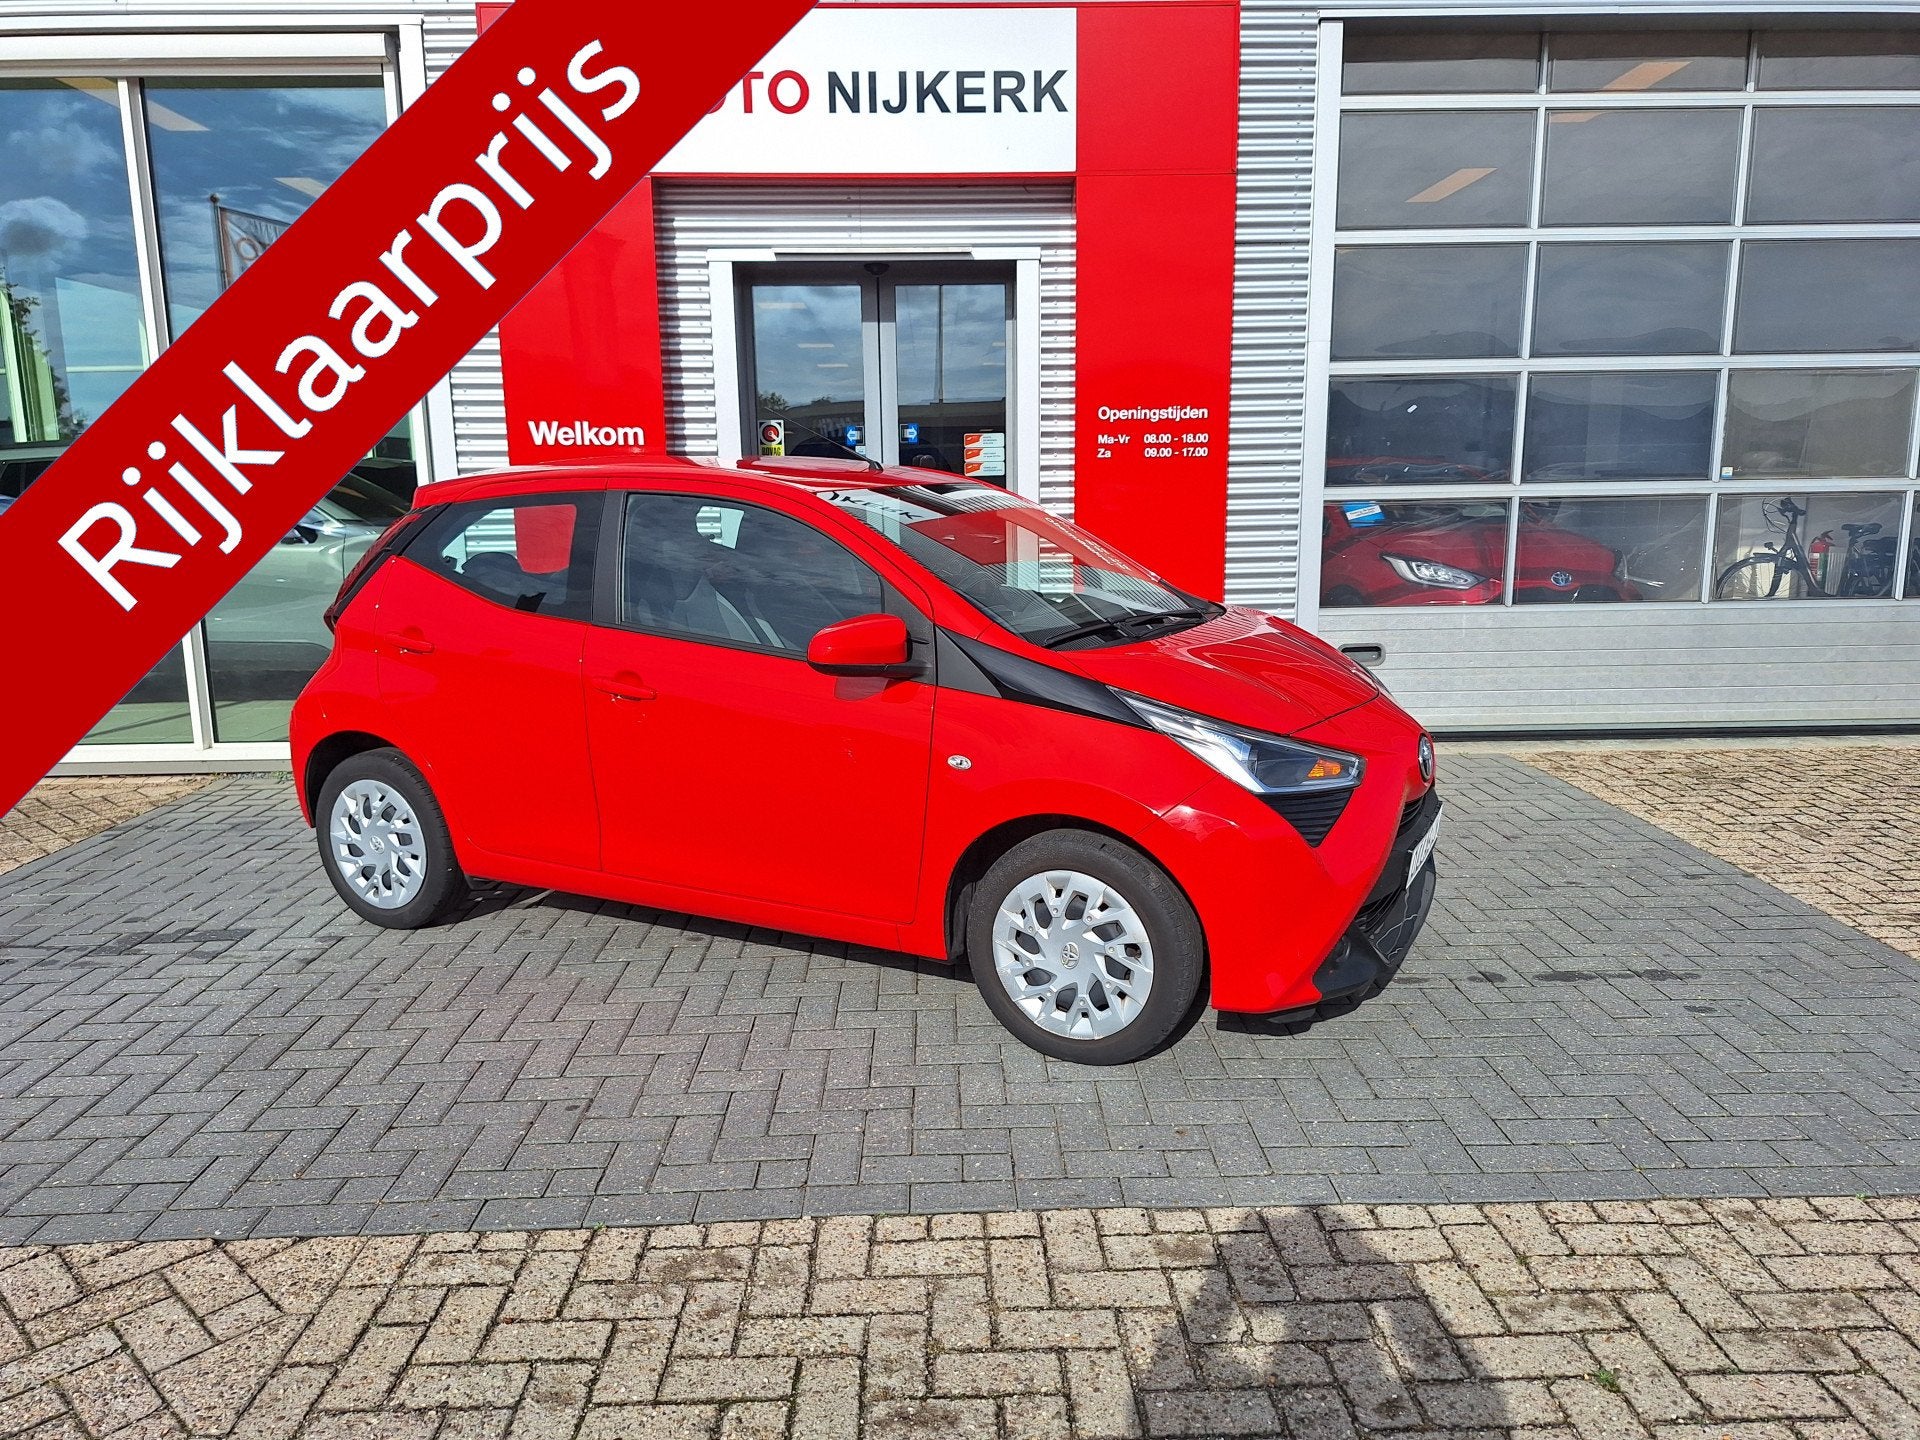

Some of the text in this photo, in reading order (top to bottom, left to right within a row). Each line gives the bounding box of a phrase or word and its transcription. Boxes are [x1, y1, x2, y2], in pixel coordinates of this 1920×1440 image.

[705, 70, 1069, 115] TO NIJKERK
[1097, 405, 1208, 422] Openingstijden
[527, 420, 645, 446] Welkom
[1097, 434, 1130, 444] Ma-Vr
[1143, 433, 1171, 443] 08.00
[1181, 433, 1209, 443] 18.00
[1097, 448, 1112, 458] Za
[1144, 447, 1172, 458] 09.00
[1181, 447, 1208, 457] 17.00
